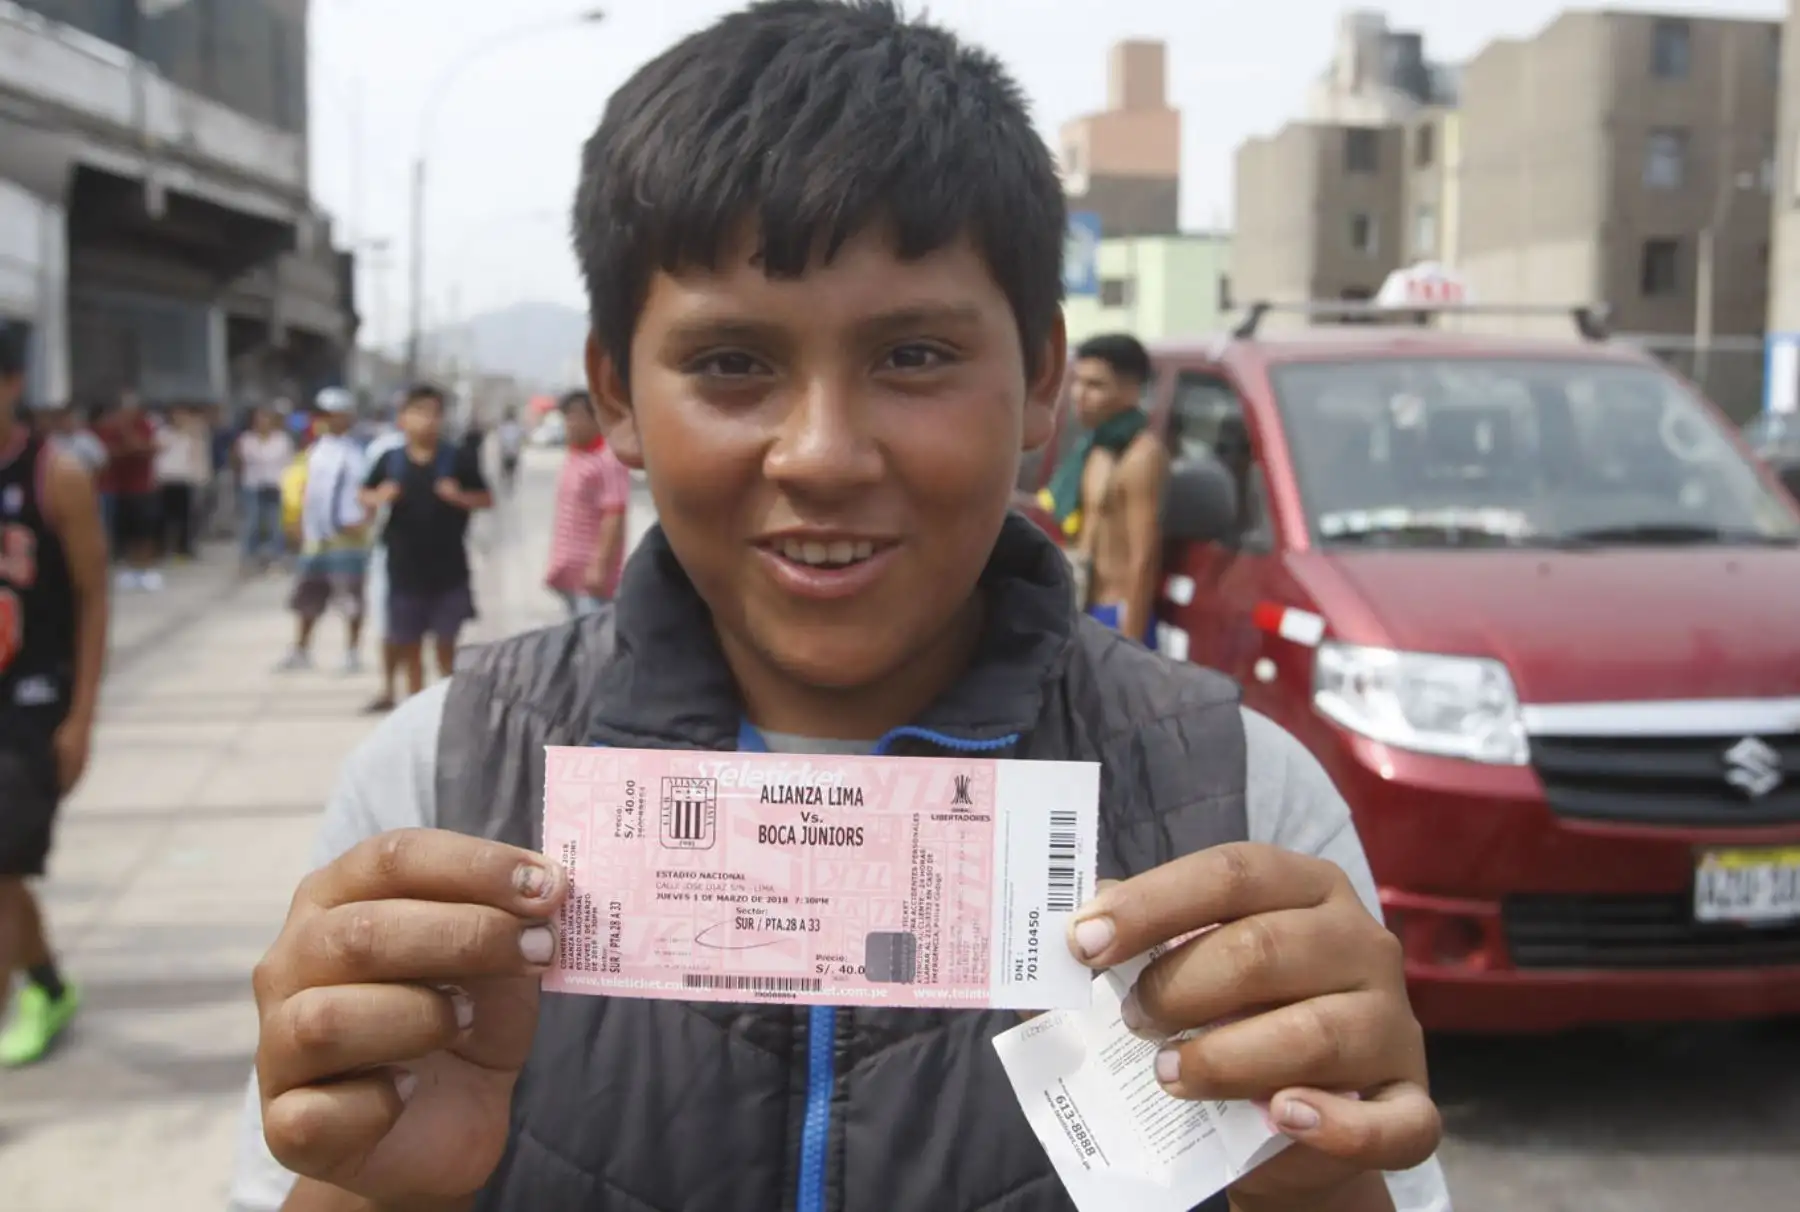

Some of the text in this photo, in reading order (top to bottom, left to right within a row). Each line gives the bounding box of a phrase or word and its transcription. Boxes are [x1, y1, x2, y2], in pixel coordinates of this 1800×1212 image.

[704, 761, 846, 788] Teleticket
[760, 785, 864, 807] ALIANZA LIMA
[624, 779, 636, 839] S/. 40.00
[801, 811, 824, 824] Vs.
[931, 814, 991, 823] LIBERTADORES
[758, 824, 864, 847] BOCA JUNIORS
[656, 871, 746, 881] ESTADIO NACIONAL
[610, 901, 621, 912] 33
[656, 893, 690, 901] JUEVES
[701, 894, 713, 902] DE
[716, 895, 749, 903] MARZO
[766, 896, 788, 904] 2018
[735, 907, 769, 916] Sector:
[735, 916, 754, 930] SUR
[765, 917, 797, 931] PTA.28
[799, 918, 806, 931] A
[808, 918, 820, 932] 33
[610, 920, 620, 948] PTA.28
[1027, 906, 1040, 982] 70110450.
[609, 956, 620, 974] SUR
[816, 953, 848, 962] Precio:
[815, 963, 866, 976] S/. 40.0
[1015, 959, 1024, 982] DNI
[1055, 1094, 1096, 1157] 613-8888
